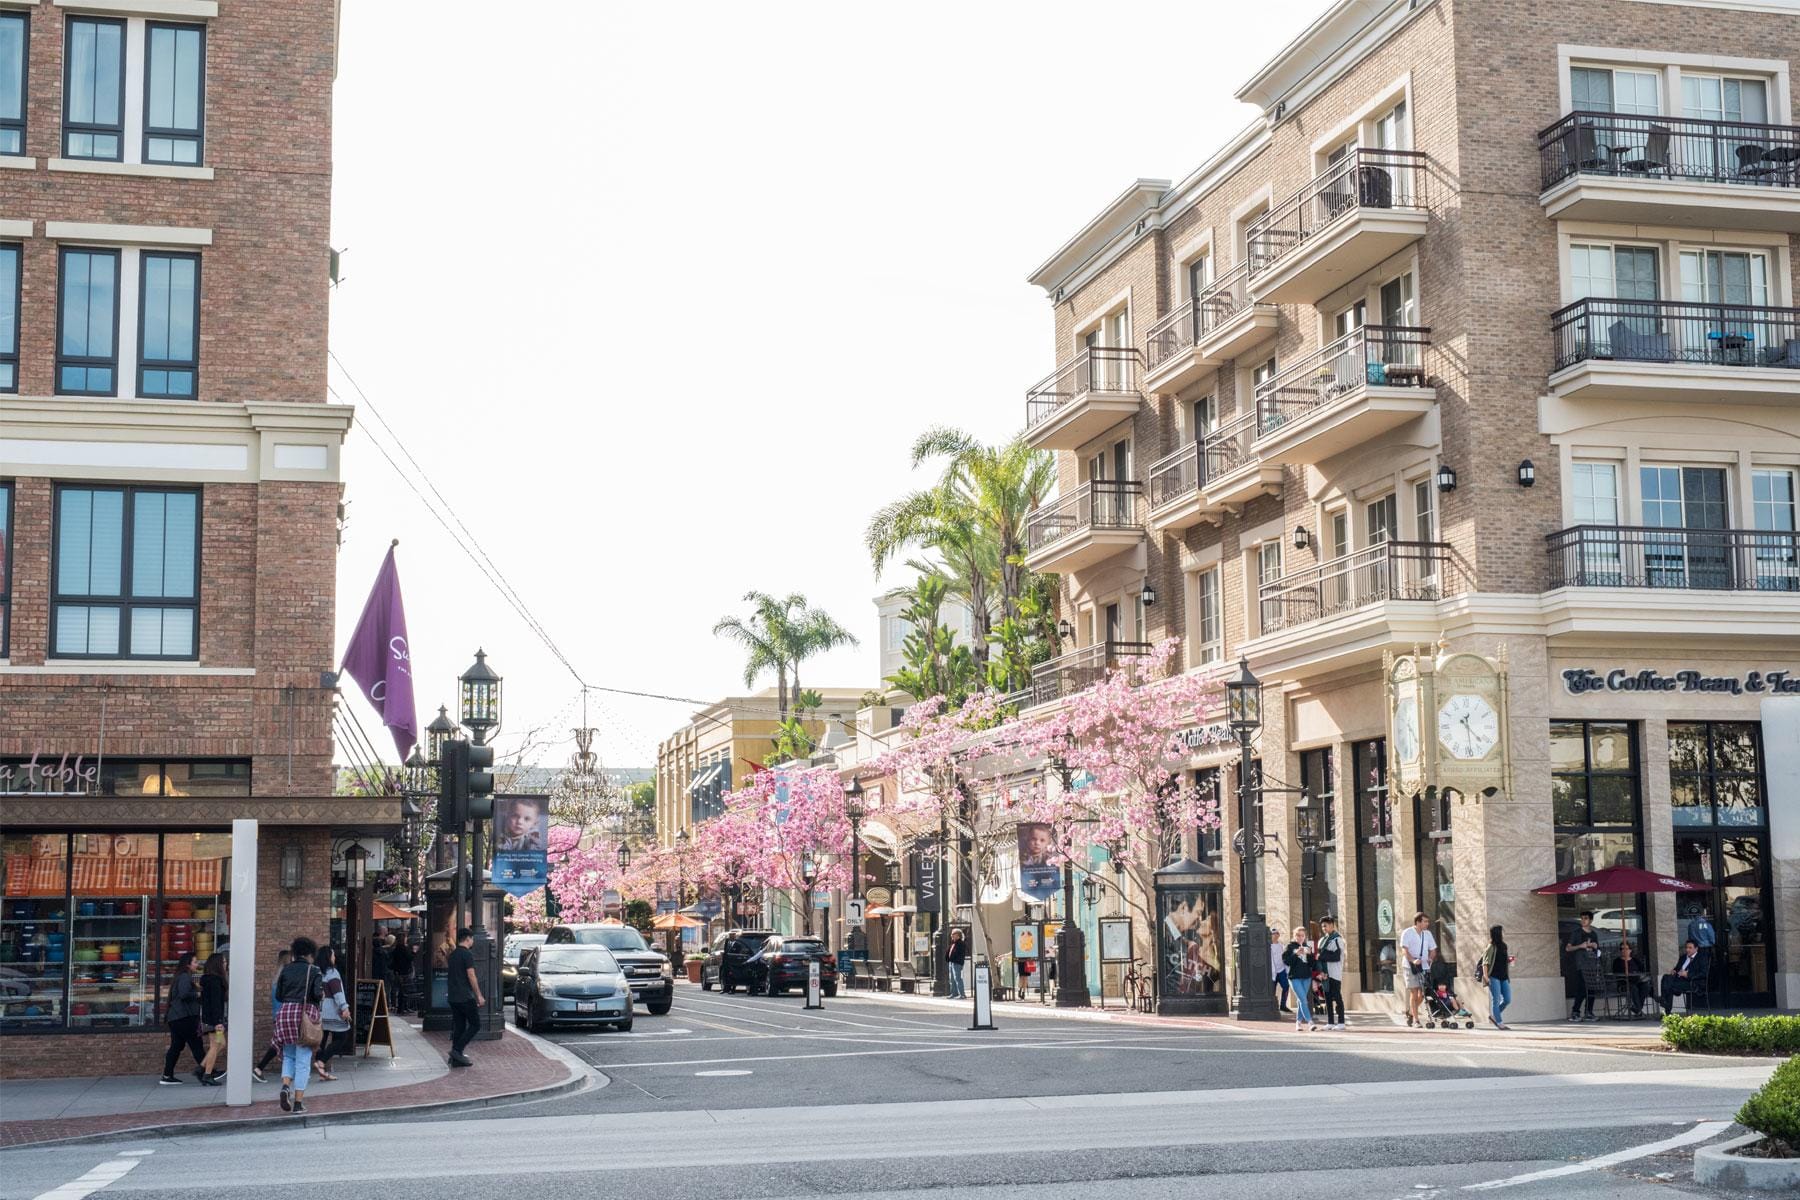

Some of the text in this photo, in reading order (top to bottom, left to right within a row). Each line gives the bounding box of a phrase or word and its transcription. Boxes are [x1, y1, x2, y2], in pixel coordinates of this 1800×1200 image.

[1562, 669, 1605, 694] The
[1607, 669, 1677, 692] Coffee
[1676, 670, 1743, 695] Bean
[1745, 671, 1766, 693] &
[19, 748, 97, 785] table
[921, 850, 935, 899] VALET
